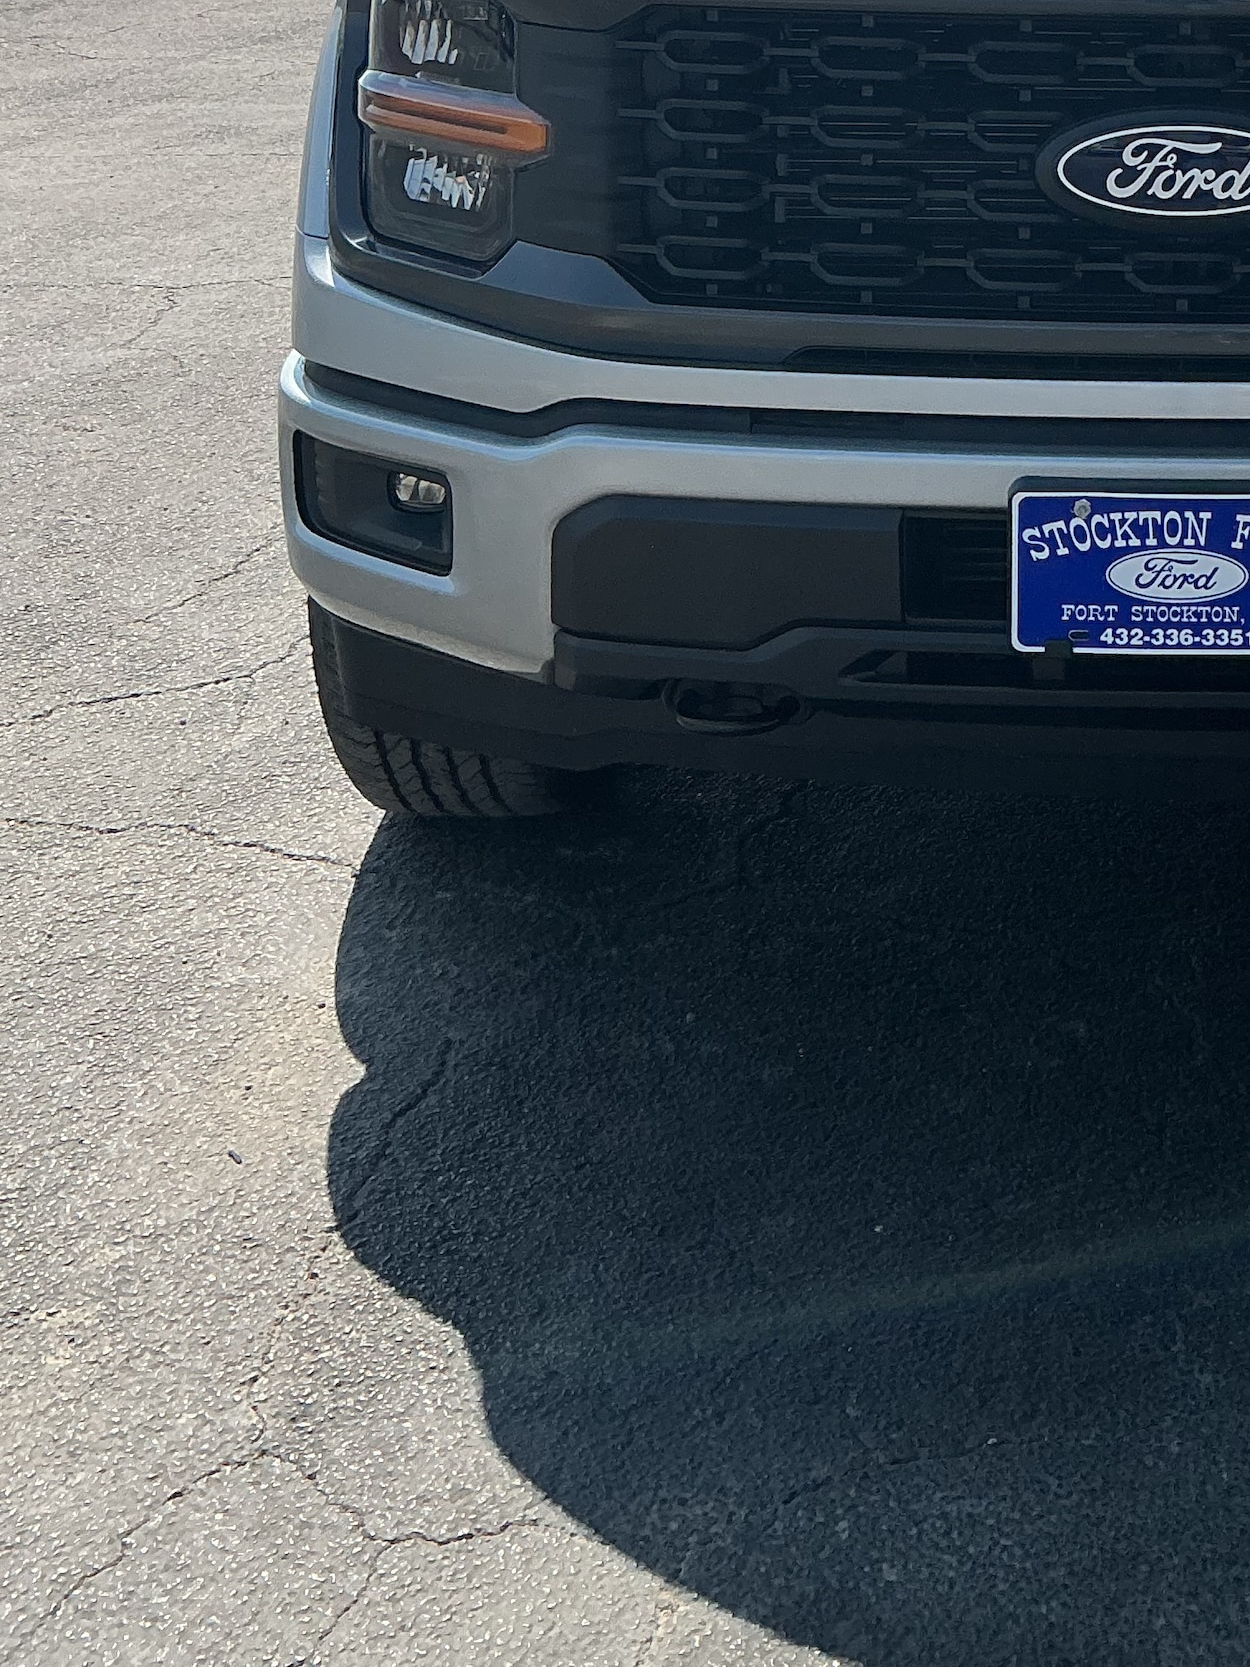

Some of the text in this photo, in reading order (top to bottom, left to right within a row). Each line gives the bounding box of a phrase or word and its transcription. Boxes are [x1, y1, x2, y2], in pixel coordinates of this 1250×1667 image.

[1021, 510, 1212, 562] STOCKTON
[1134, 557, 1219, 591] Ford
[1061, 605, 1119, 622] FORT
[1130, 606, 1245, 625] STOCKTON,
